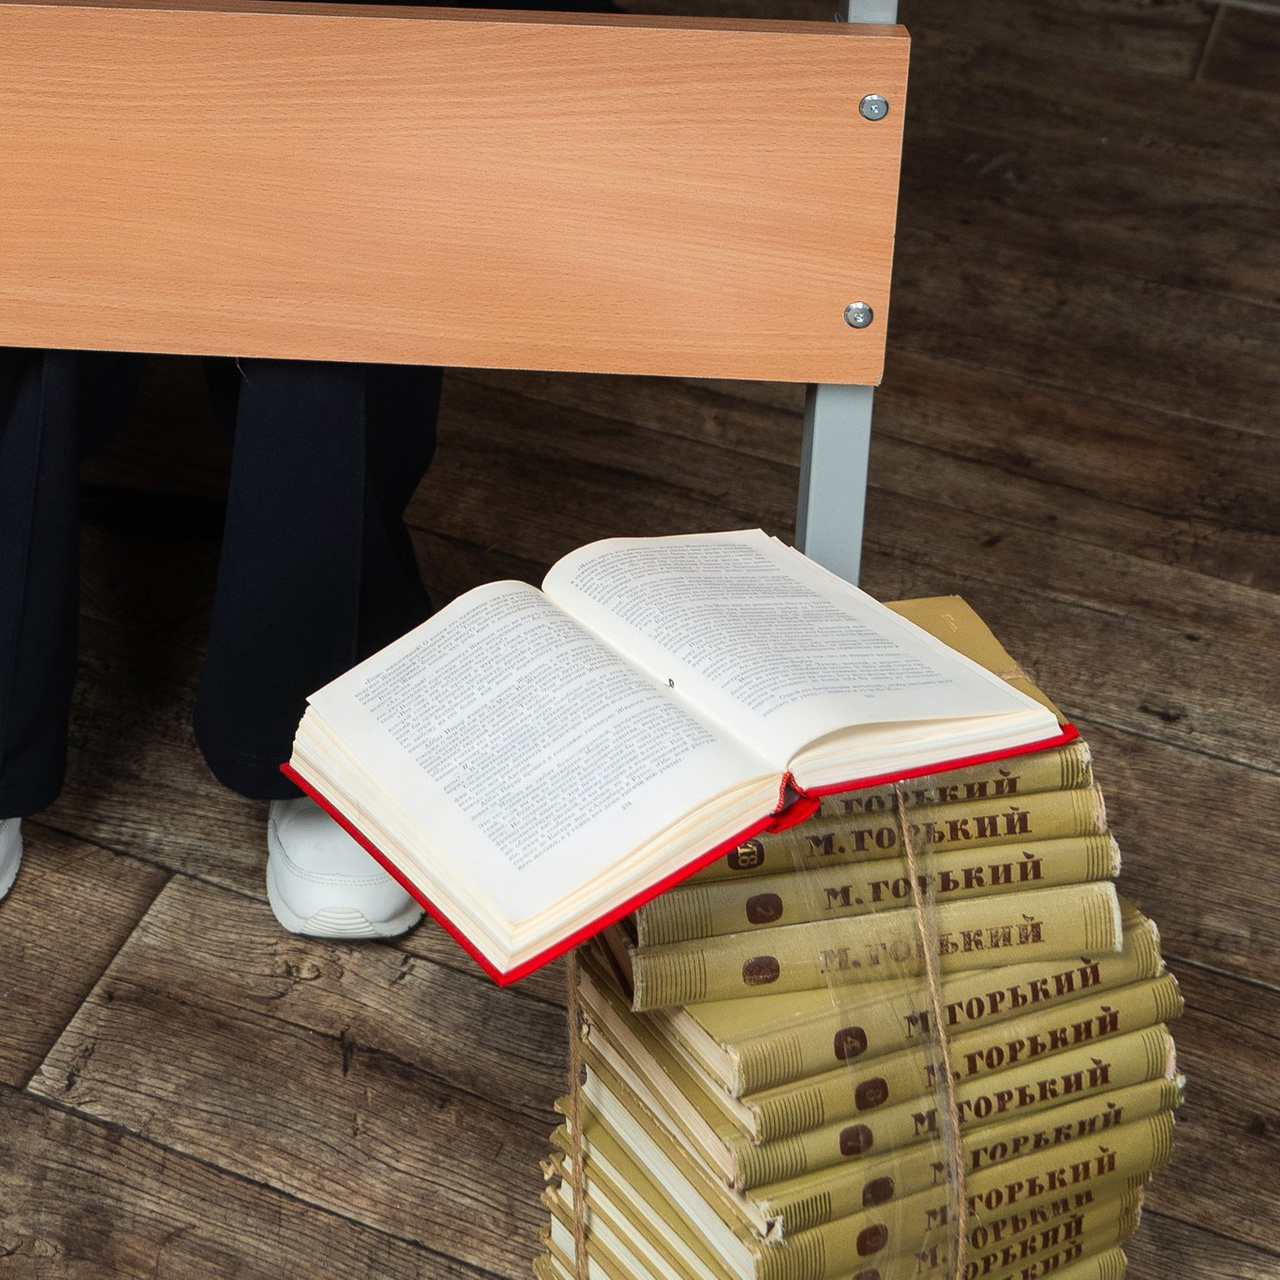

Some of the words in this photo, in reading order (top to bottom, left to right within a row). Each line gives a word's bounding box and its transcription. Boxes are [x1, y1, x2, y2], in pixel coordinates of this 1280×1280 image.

[806, 833, 846, 858] М.
[852, 806, 1033, 852] ГОРЬКИЙ
[824, 884, 863, 911] М.
[943, 956, 1101, 1026] ГОРЬКИЙ
[963, 1006, 1120, 1077] ГОРЬКИЙ
[956, 1057, 1111, 1122] ГОРЬКИЙ
[970, 1102, 1124, 1170] ГОРЬКИЙ
[964, 1213, 1084, 1280] ОРЬКИЙ
